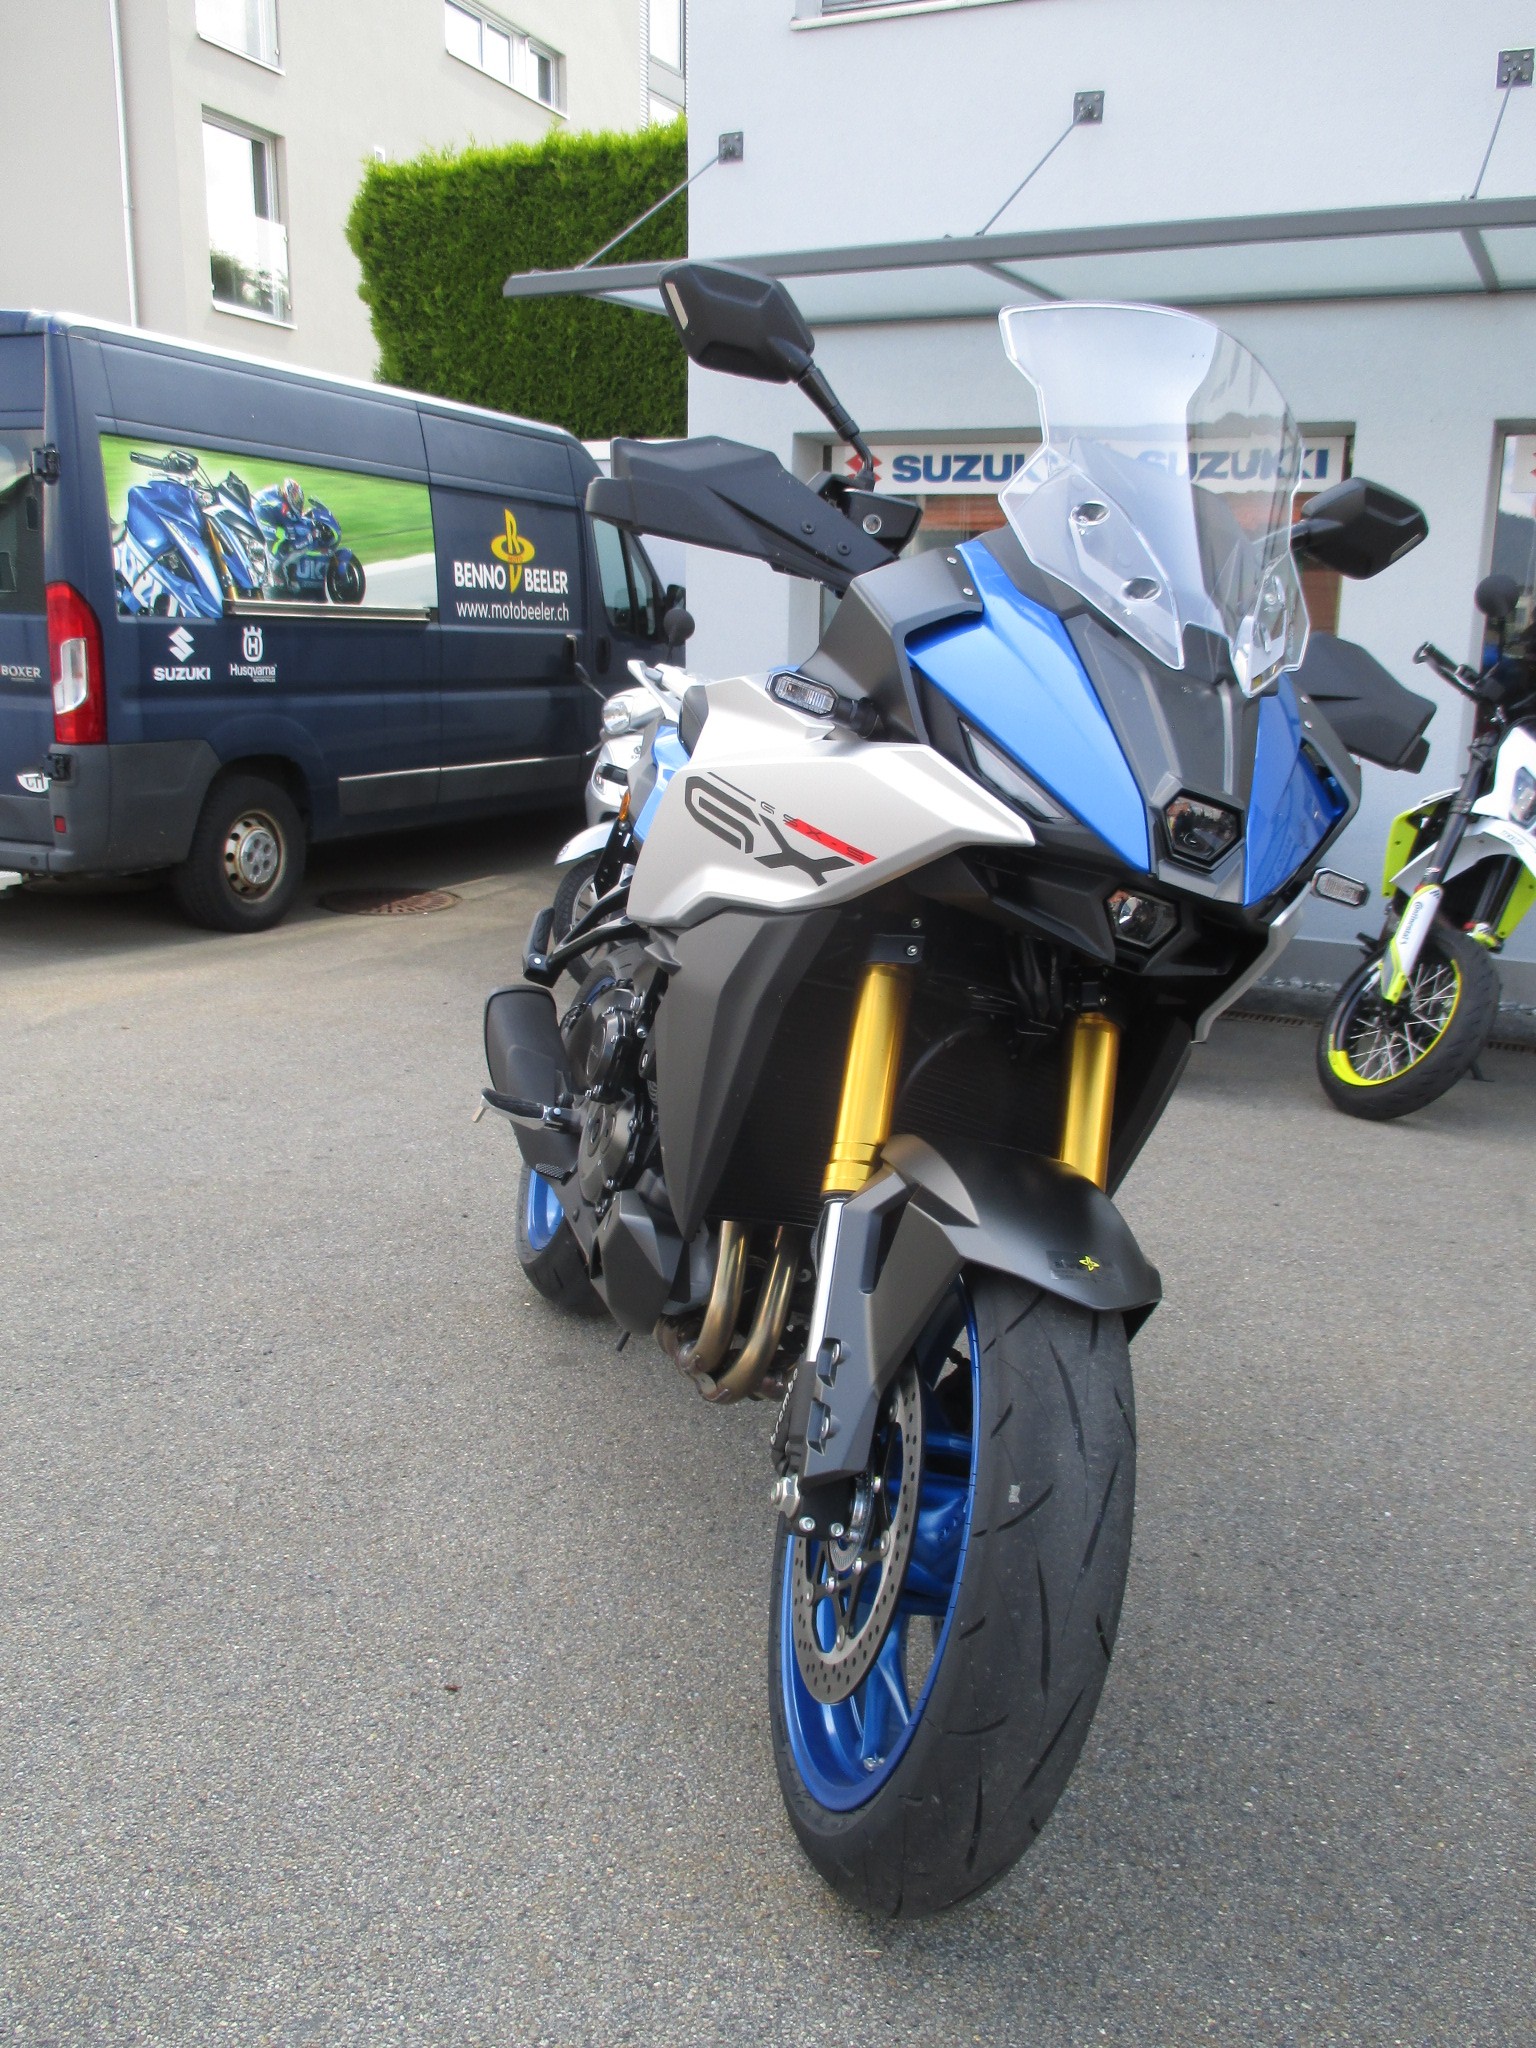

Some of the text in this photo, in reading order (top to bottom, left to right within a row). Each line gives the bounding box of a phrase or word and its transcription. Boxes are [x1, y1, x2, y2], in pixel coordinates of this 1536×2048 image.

[453, 561, 569, 594] BENNO BEELER
[456, 600, 570, 622] www.motobeeler.ch
[0, 665, 42, 678] BOXER
[153, 666, 211, 681] SUZUKI
[229, 662, 277, 680] Husqvarna
